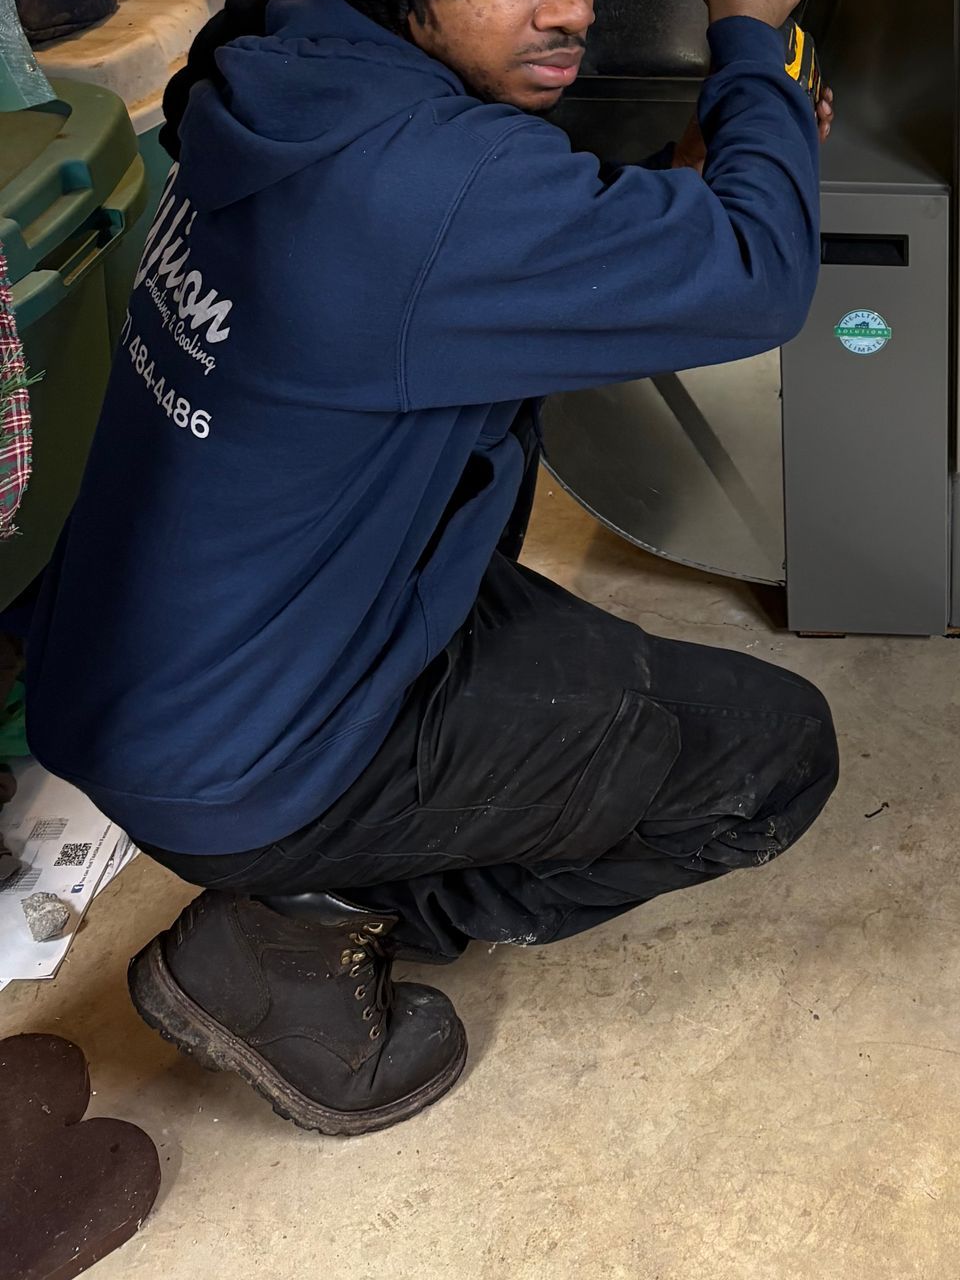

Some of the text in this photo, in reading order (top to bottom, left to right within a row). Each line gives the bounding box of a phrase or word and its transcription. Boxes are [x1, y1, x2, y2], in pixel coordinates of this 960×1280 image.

[145, 272, 217, 376] Heating & Cooling
[843, 312, 884, 327] HEALTHY
[843, 339, 884, 353] CLIMATE
[128, 335, 212, 439] 484-4486
